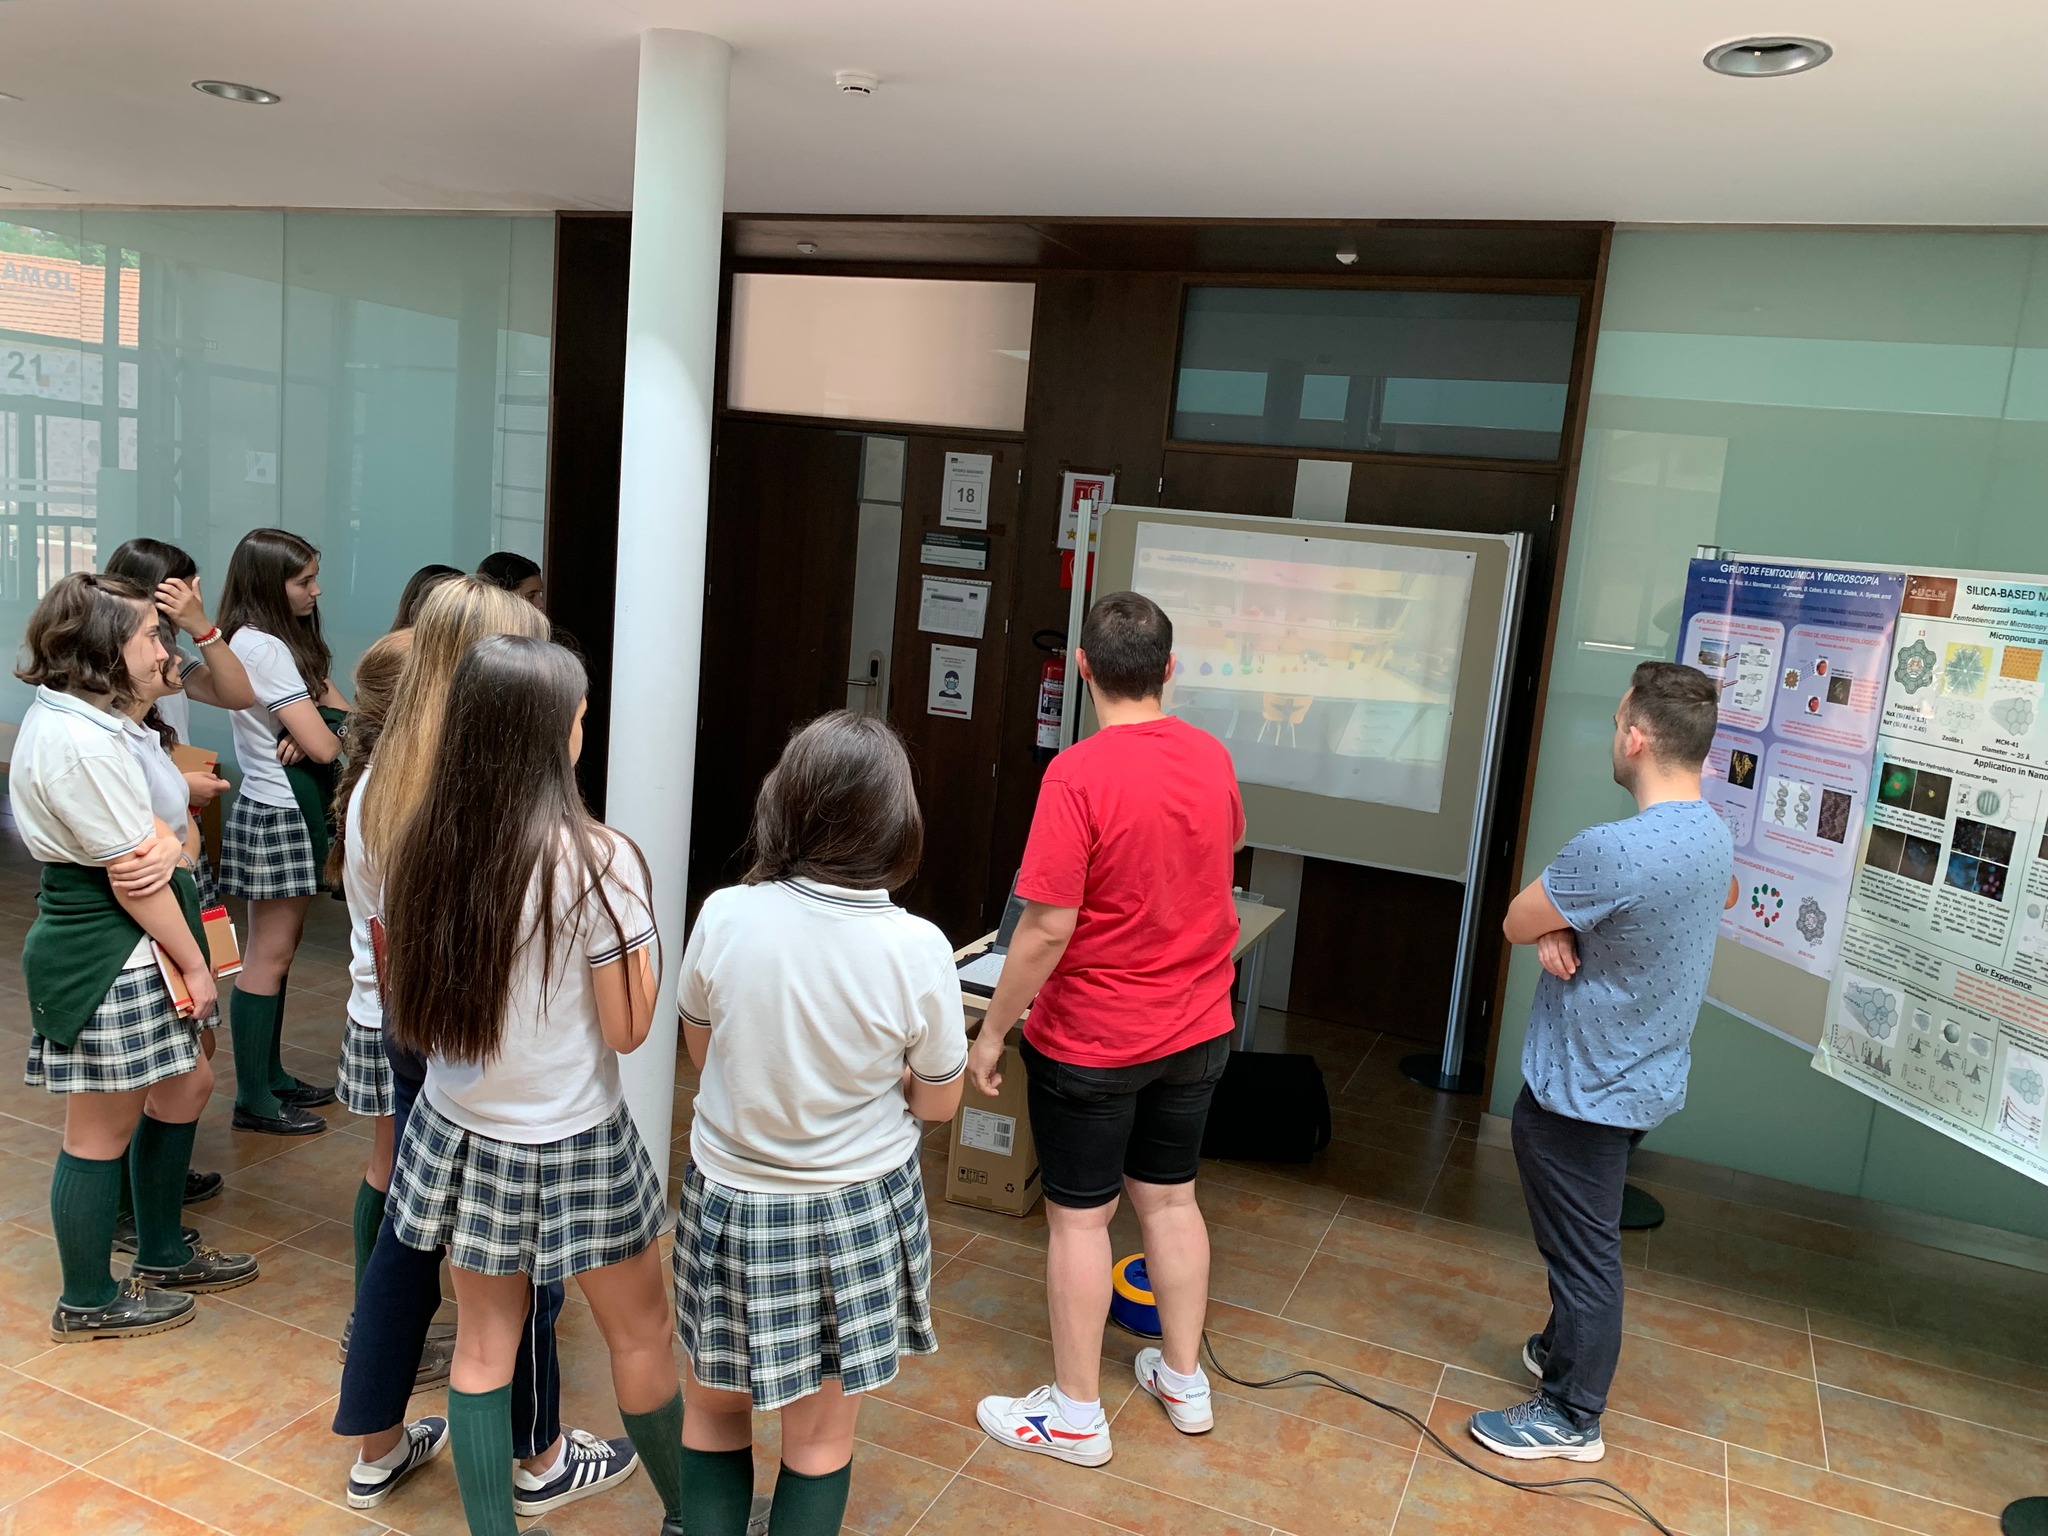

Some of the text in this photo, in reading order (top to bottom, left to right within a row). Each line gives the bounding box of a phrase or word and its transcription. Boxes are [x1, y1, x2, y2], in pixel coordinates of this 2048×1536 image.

[7, 350, 43, 381] 21
[957, 487, 975, 504] 18
[1720, 563, 1880, 586] GRUPO DE FEMTOQUÍMICA Y MICROSCOPÍA
[1917, 588, 1947, 599] UCLM
[1966, 585, 2036, 601] SILICA-BASED
[1971, 603, 2011, 614] Abderrazzak
[2012, 607, 2038, 618] Douhal,
[1953, 614, 1996, 625] Femtoscience
[2009, 619, 2047, 632] Microscopy
[1989, 631, 2036, 643] Microporous
[1942, 735, 1959, 744] Zeolite
[1995, 738, 2019, 748] MCM-41
[1981, 745, 2008, 756] Diameter
[2016, 752, 2025, 760] 25
[1902, 757, 1918, 766] System
[1926, 763, 1955, 774] Hydrophobic
[1955, 769, 1982, 780] Anticancer
[1982, 775, 1998, 784] Drugs
[1973, 758, 2017, 774] Application
[2018, 767, 2026, 776] in
[1975, 963, 2033, 991] Our Experience
[1904, 1099, 1925, 1113] supported
[1185, 1391, 1207, 1400] Reebok
